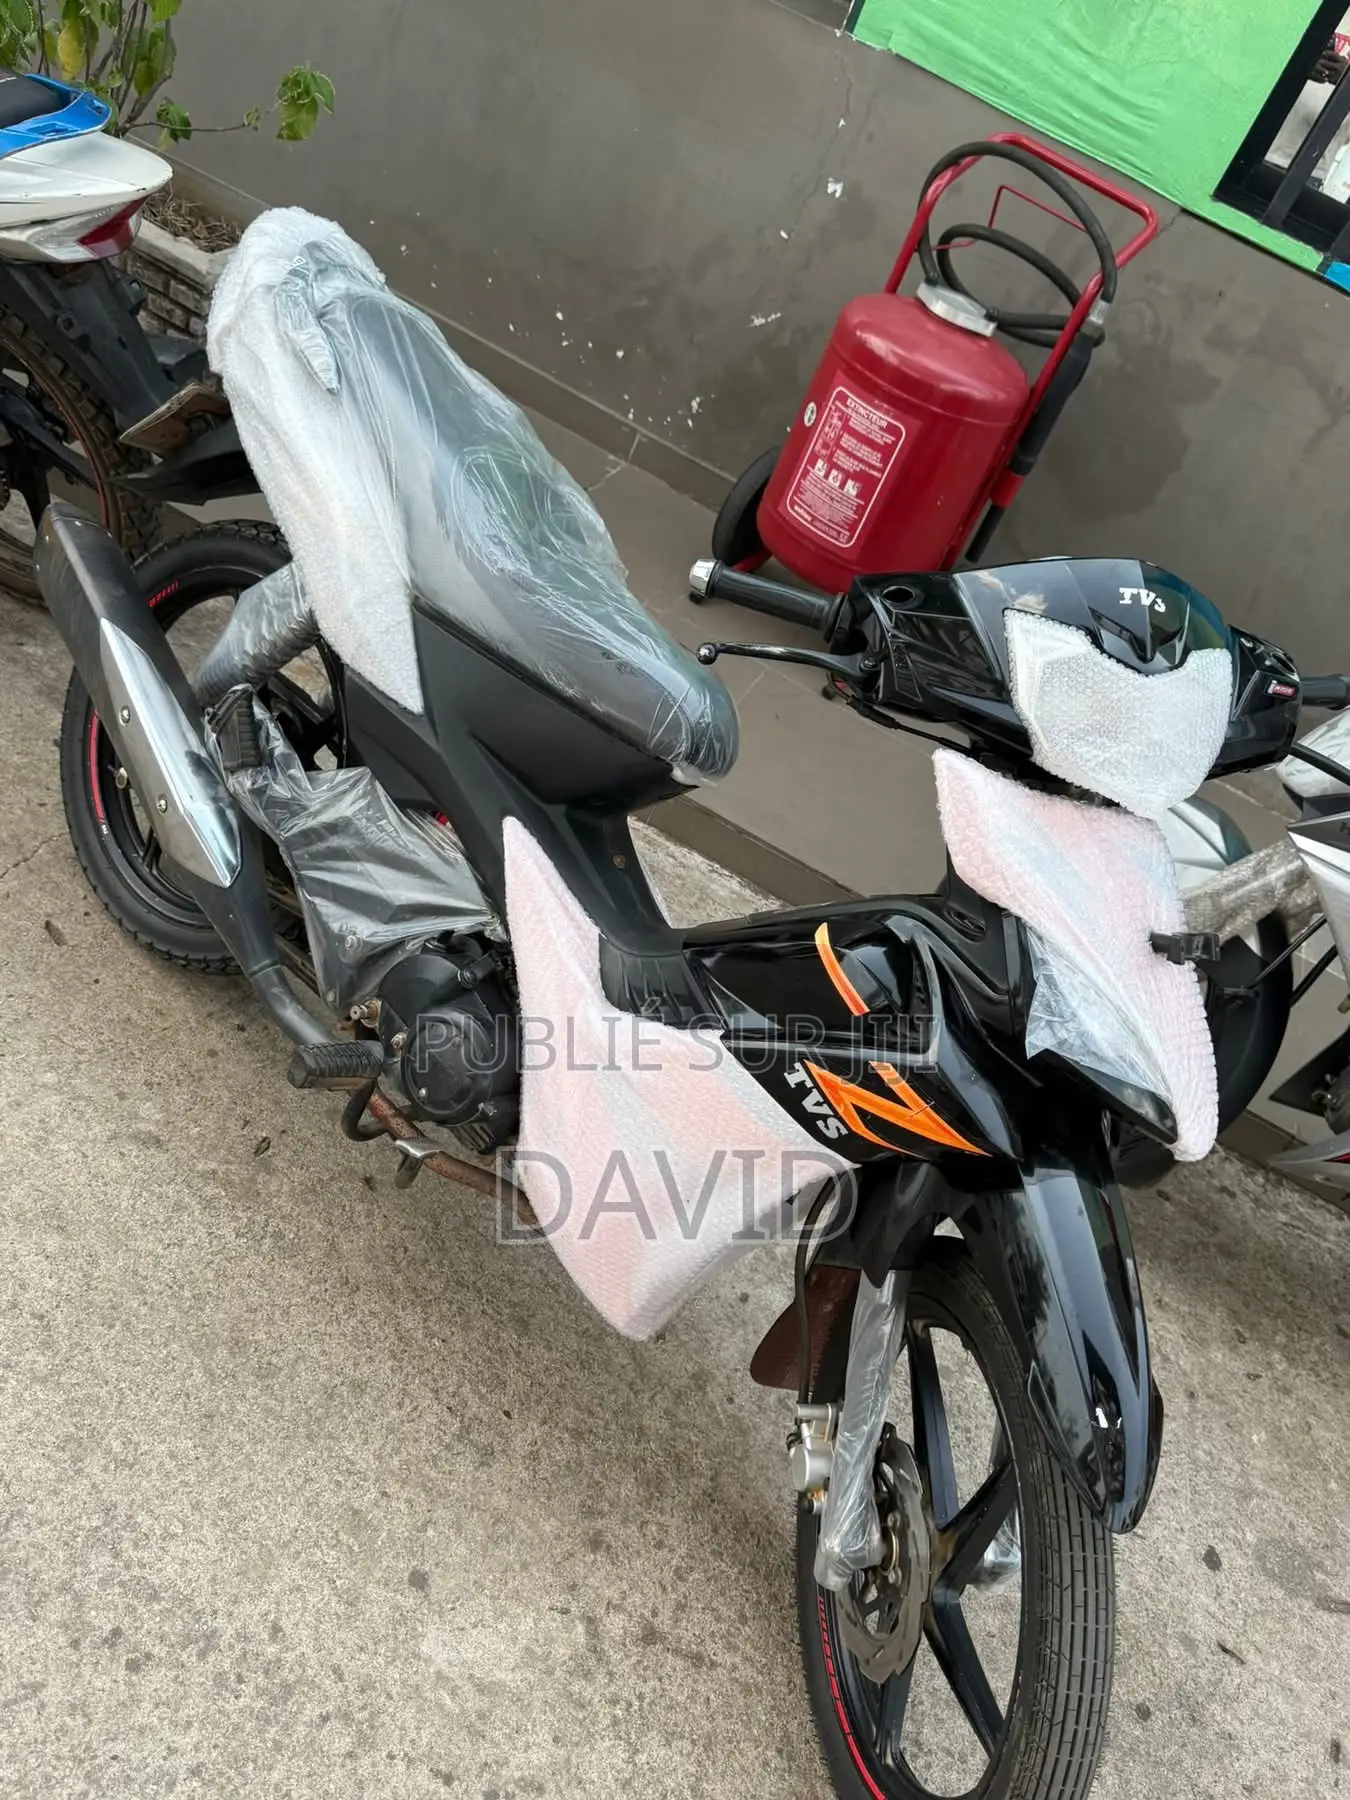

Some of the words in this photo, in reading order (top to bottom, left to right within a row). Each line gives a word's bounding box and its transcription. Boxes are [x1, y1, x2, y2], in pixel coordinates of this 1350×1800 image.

[847, 398, 888, 429] EXTINCTEUR
[1119, 587, 1166, 613] TVS
[784, 1062, 848, 1139] TVS
